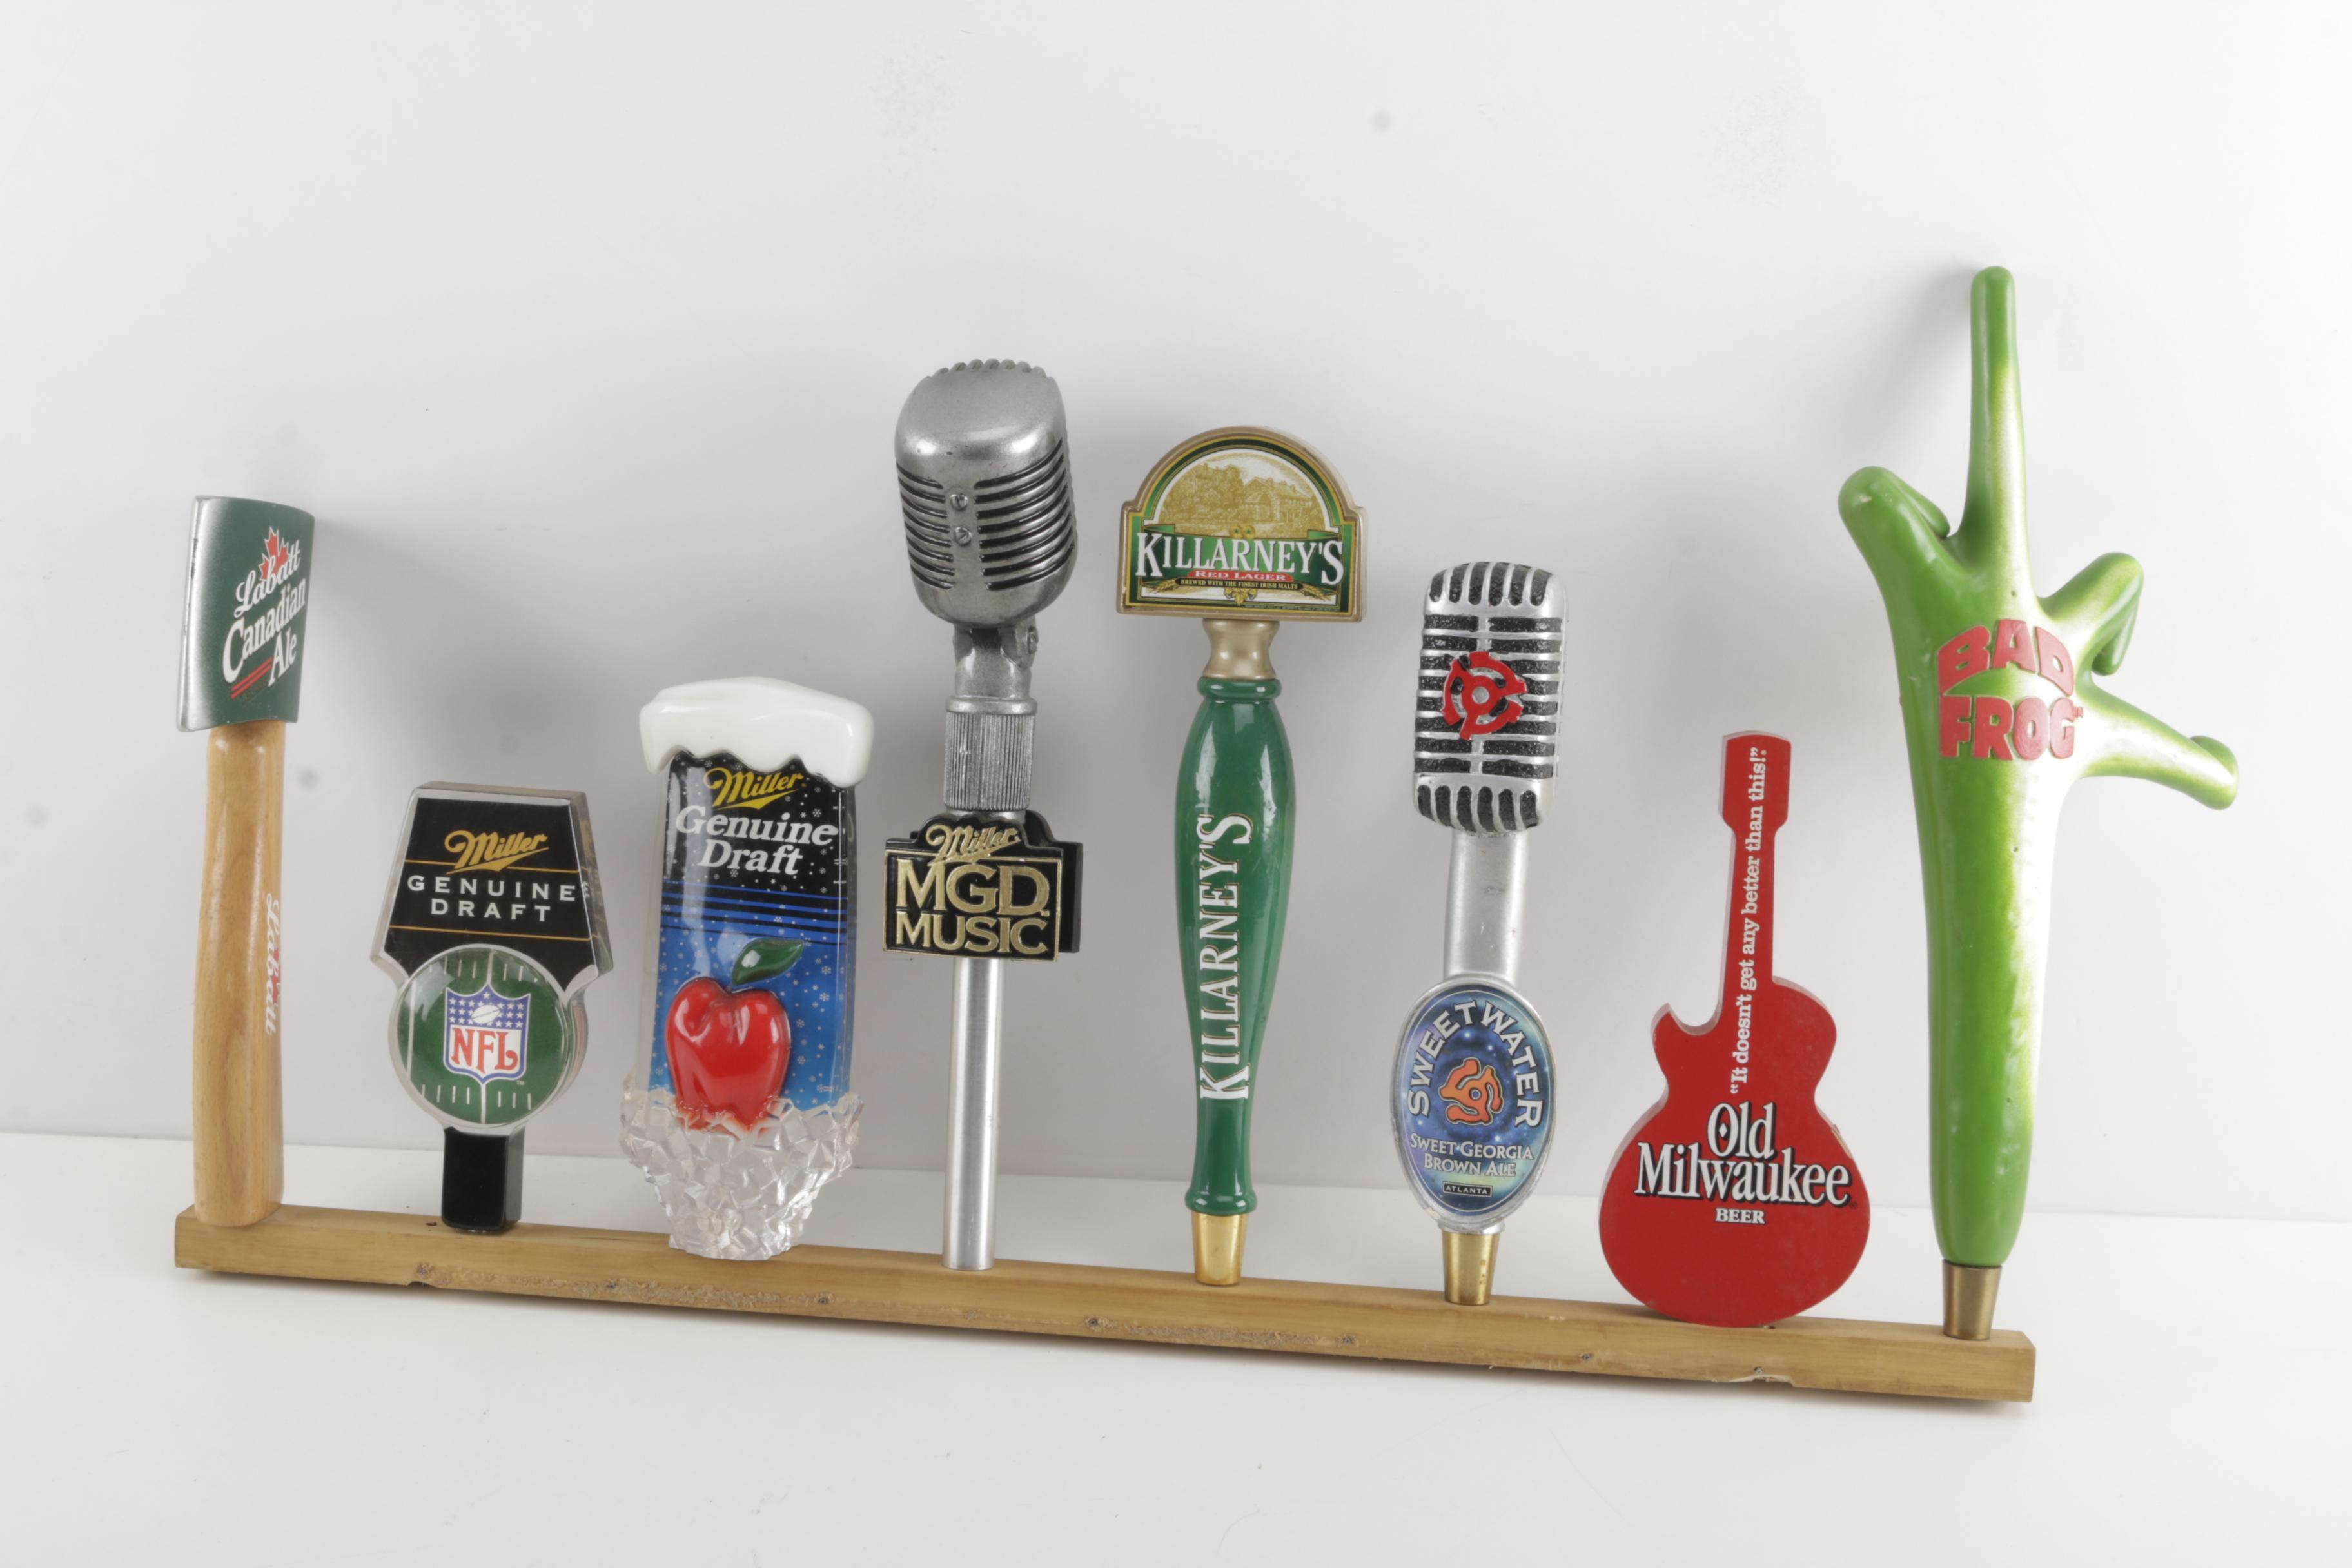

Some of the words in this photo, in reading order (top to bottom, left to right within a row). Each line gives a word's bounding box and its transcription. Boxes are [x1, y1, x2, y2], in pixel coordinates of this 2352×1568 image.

[234, 539, 301, 618] Labatt
[1135, 533, 1344, 585] KILLARNEY'S
[1234, 571, 1286, 580] LAGER
[222, 578, 306, 683] Canadian
[268, 626, 297, 687] Ale
[1937, 618, 2075, 697] BAD
[1940, 695, 2075, 761] FROG
[703, 767, 804, 810] Miller
[676, 805, 839, 846] Genuine
[925, 823, 1022, 867] Miller
[1745, 805, 1763, 851] than
[444, 829, 549, 875] Miller
[698, 839, 803, 876] Draft
[407, 874, 576, 902] GENUINE
[896, 858, 1050, 916] MGD
[1741, 856, 1760, 914] better
[431, 898, 551, 922] DRAFT
[896, 910, 1048, 954] MUSIC
[1196, 813, 1254, 1100] KILLARNEY'S
[1742, 918, 1760, 955] any
[1739, 959, 1757, 991] get
[451, 1027, 518, 1073] NFL
[1732, 994, 1752, 1064] doesn't
[1408, 1000, 1544, 1128] SWEETWATER
[1410, 1133, 1456, 1155] SWEET
[1460, 1141, 1535, 1160] GEORGIA
[1707, 1101, 1777, 1159] Old
[1424, 1153, 1482, 1175] BROWN
[1485, 1161, 1516, 1177] ALE
[1634, 1141, 1852, 1207] Milwaukee
[1446, 1185, 1489, 1195] ATLANTA
[1715, 1207, 1765, 1224] BEER
